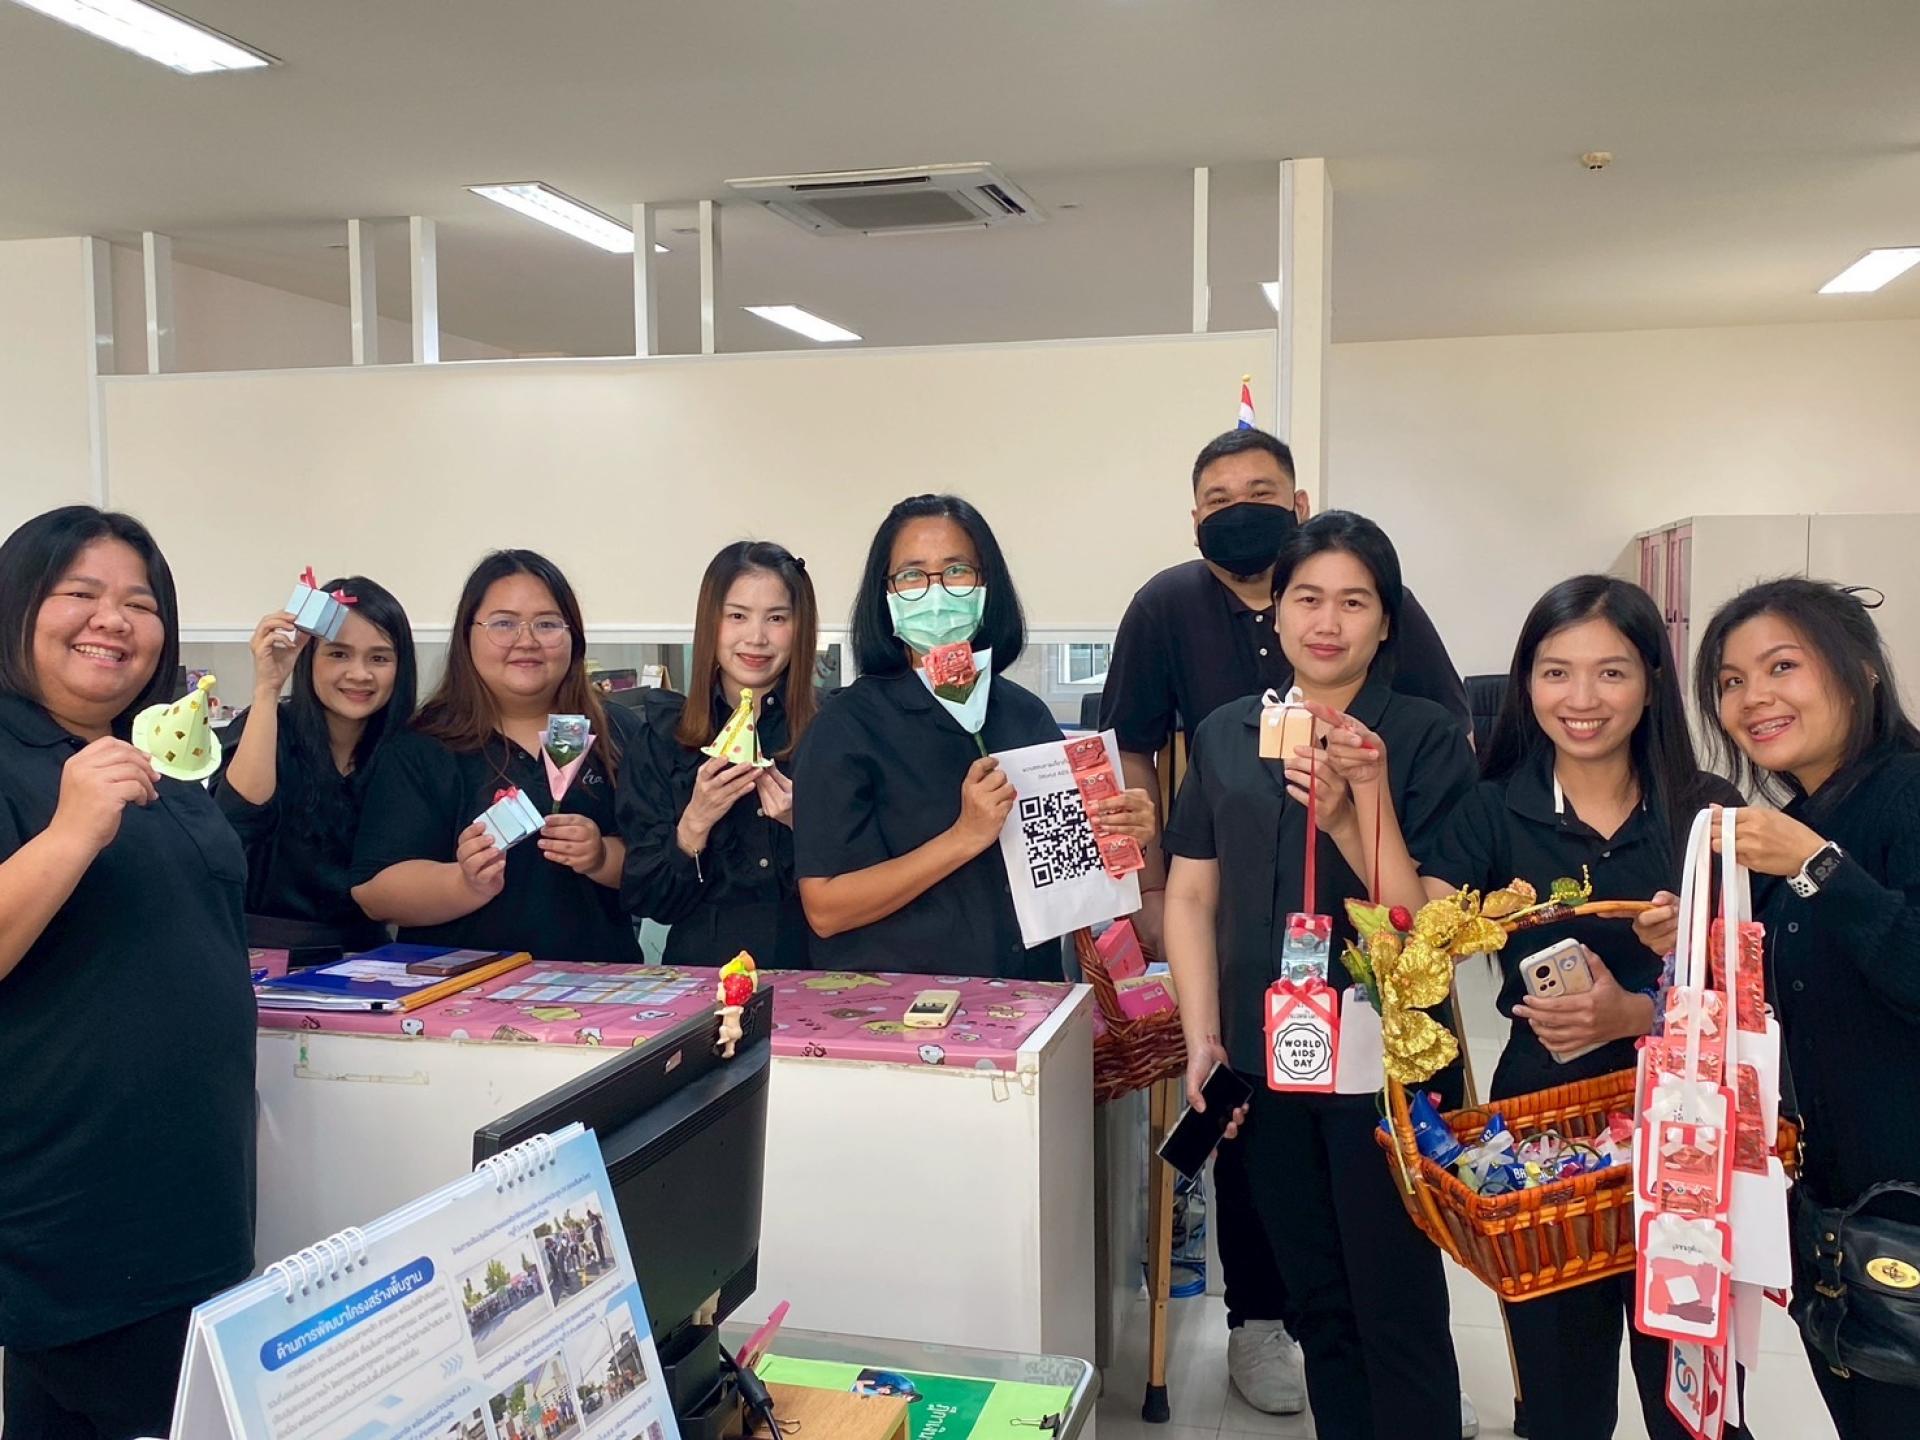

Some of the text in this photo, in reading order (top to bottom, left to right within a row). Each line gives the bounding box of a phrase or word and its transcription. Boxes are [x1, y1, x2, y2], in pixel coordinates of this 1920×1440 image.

[1285, 1040, 1321, 1048] WORLD
[1291, 1049, 1316, 1058] AIDS
[1293, 1059, 1313, 1068] DAY
[276, 1270, 424, 1361] ด้านการพัฒนาโครงสร้างพื้นฐาน
